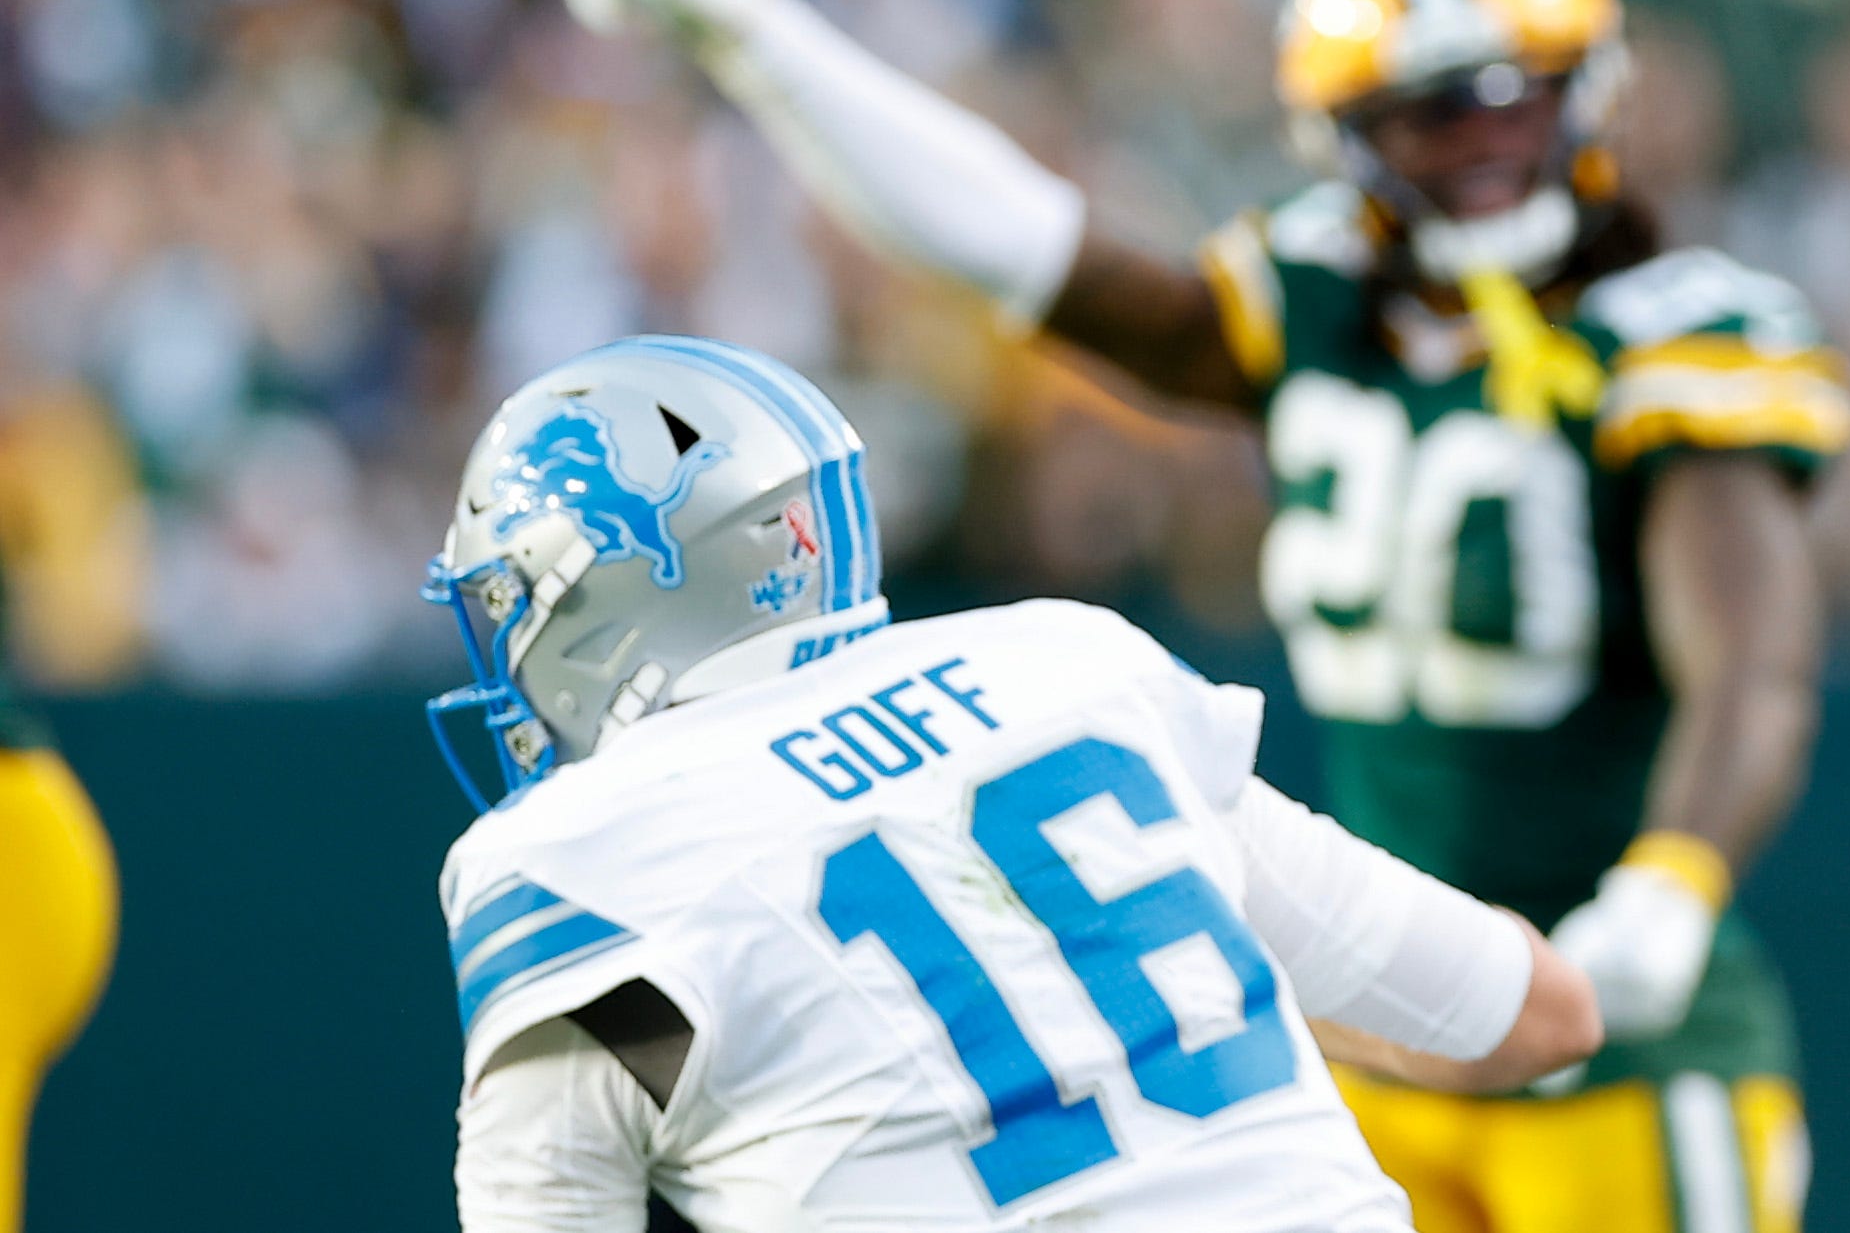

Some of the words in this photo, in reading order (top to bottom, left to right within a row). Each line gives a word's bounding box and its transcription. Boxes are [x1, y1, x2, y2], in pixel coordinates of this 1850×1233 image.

[768, 656, 1001, 802] GOFF
[1259, 369, 1600, 730] 20
[813, 735, 1302, 1209] 16
